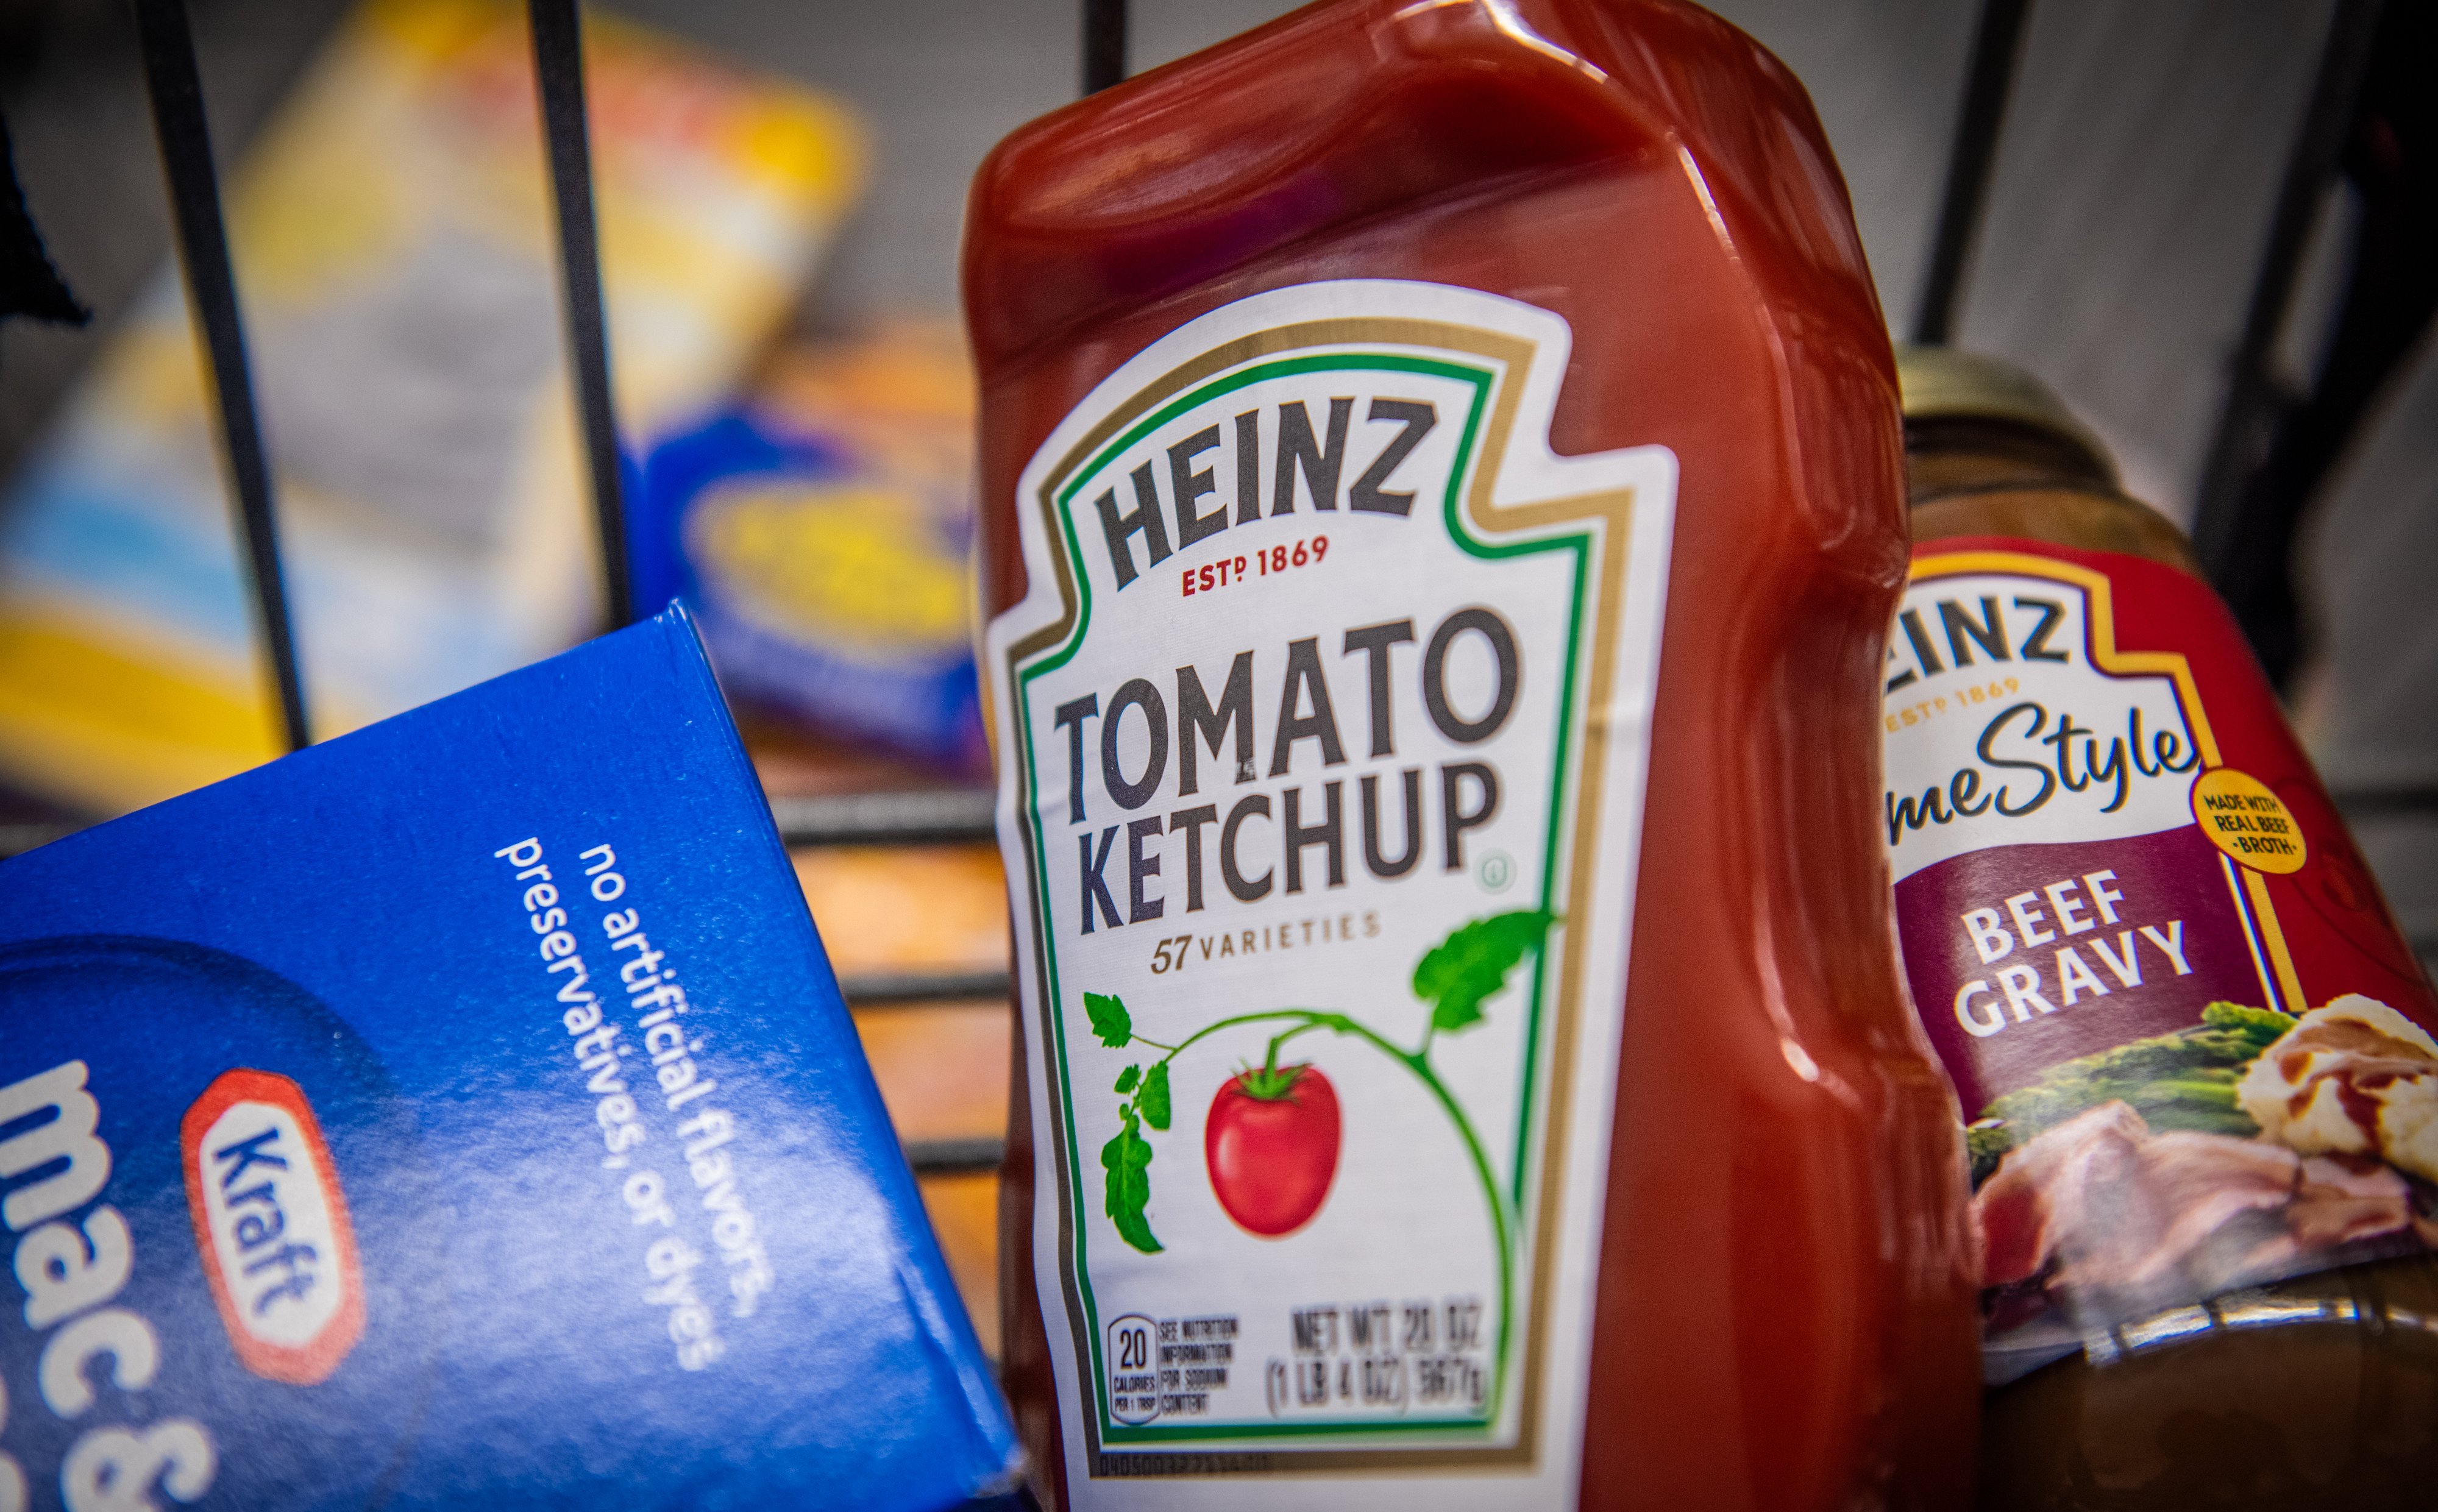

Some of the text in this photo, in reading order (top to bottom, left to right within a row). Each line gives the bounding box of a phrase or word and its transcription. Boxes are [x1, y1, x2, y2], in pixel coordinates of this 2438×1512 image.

[1093, 396, 1439, 592] HEINZ
[1257, 535, 1330, 577] 1869
[1054, 607, 1519, 826] TOMATO
[1955, 676, 2020, 709] 1869
[2203, 794, 2282, 814] MADE WITH
[2214, 815, 2290, 834] REAL BEEF
[1078, 762, 1502, 936] KETCHUP
[1150, 910, 1382, 975] 57 VARIETIES
[1961, 869, 2125, 965] BEEF
[1954, 920, 2194, 1037] GRAVY
[494, 837, 727, 1372] preservatives, or dyes
[579, 843, 775, 1318] no artificial flavors,
[211, 1126, 319, 1318] Kraft
[0, 1059, 219, 1512] mac &
[1119, 1328, 1147, 1369] 20
[1159, 1318, 1239, 1341] SEE NUTRITION
[1160, 1343, 1233, 1364] INFORMATION
[1292, 1305, 1338, 1355] NET
[1346, 1302, 1393, 1354] WT
[1113, 1375, 1156, 1394] CALORIES
[1160, 1369, 1181, 1391] FOR
[1160, 1393, 1209, 1416] CONTENT
[1296, 1357, 1330, 1408] LB
